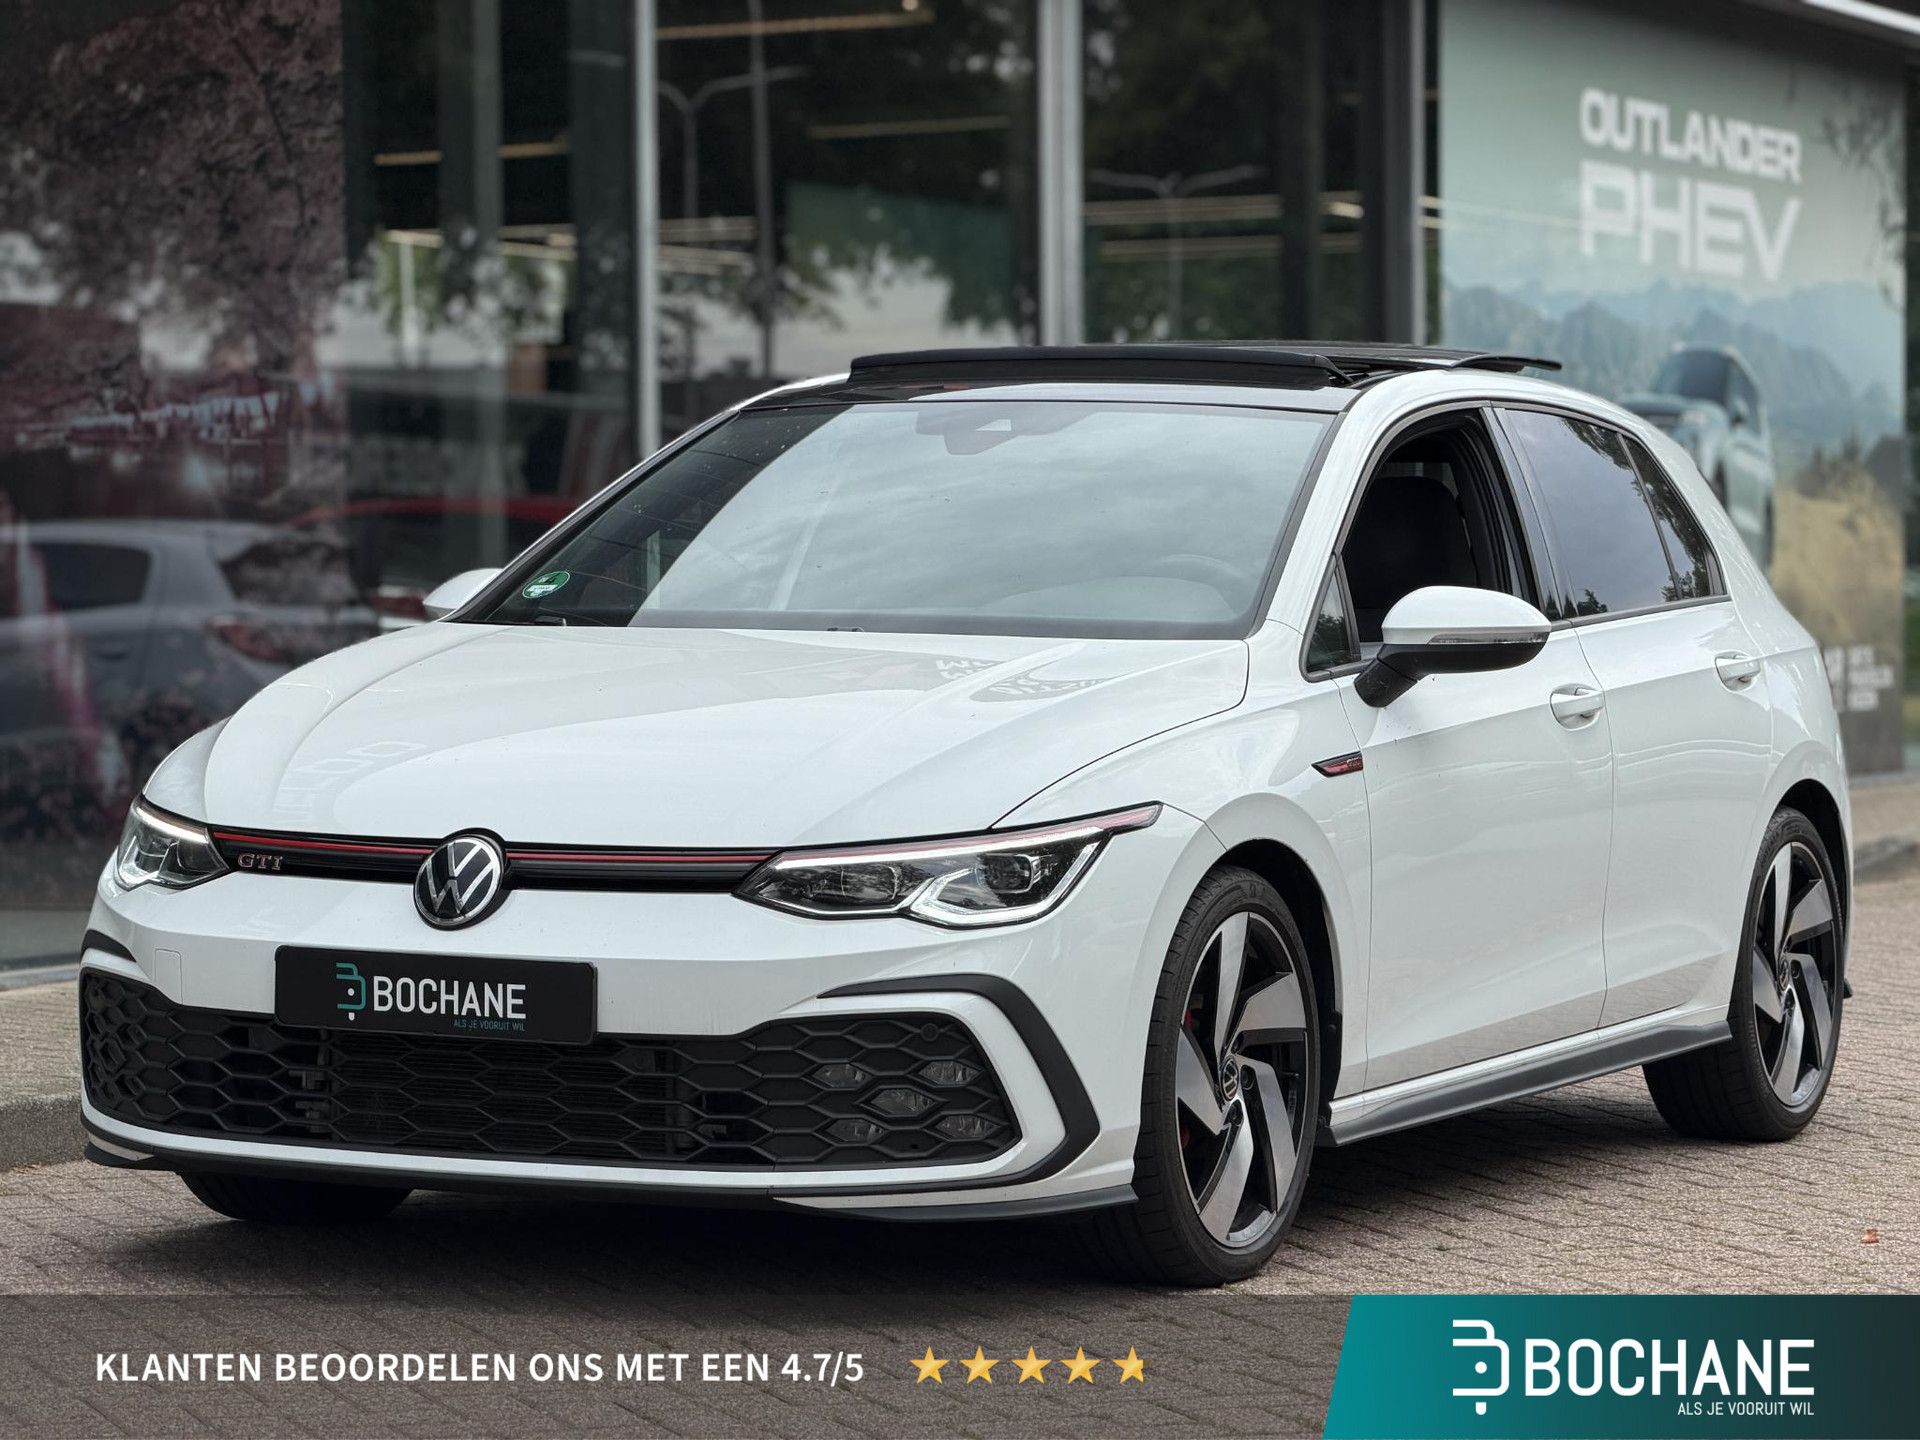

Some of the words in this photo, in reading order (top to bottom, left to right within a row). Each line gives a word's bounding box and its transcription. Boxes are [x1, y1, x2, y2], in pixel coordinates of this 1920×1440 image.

[1582, 89, 1801, 181] OUTLANDER
[1582, 161, 1800, 281] PHEV
[237, 853, 283, 871] GTI
[373, 975, 526, 1019] BOCHANE
[453, 1019, 467, 1028] ALS
[469, 1020, 477, 1029] JE
[480, 1020, 510, 1031] VOORUIT
[512, 1022, 525, 1032] WIL
